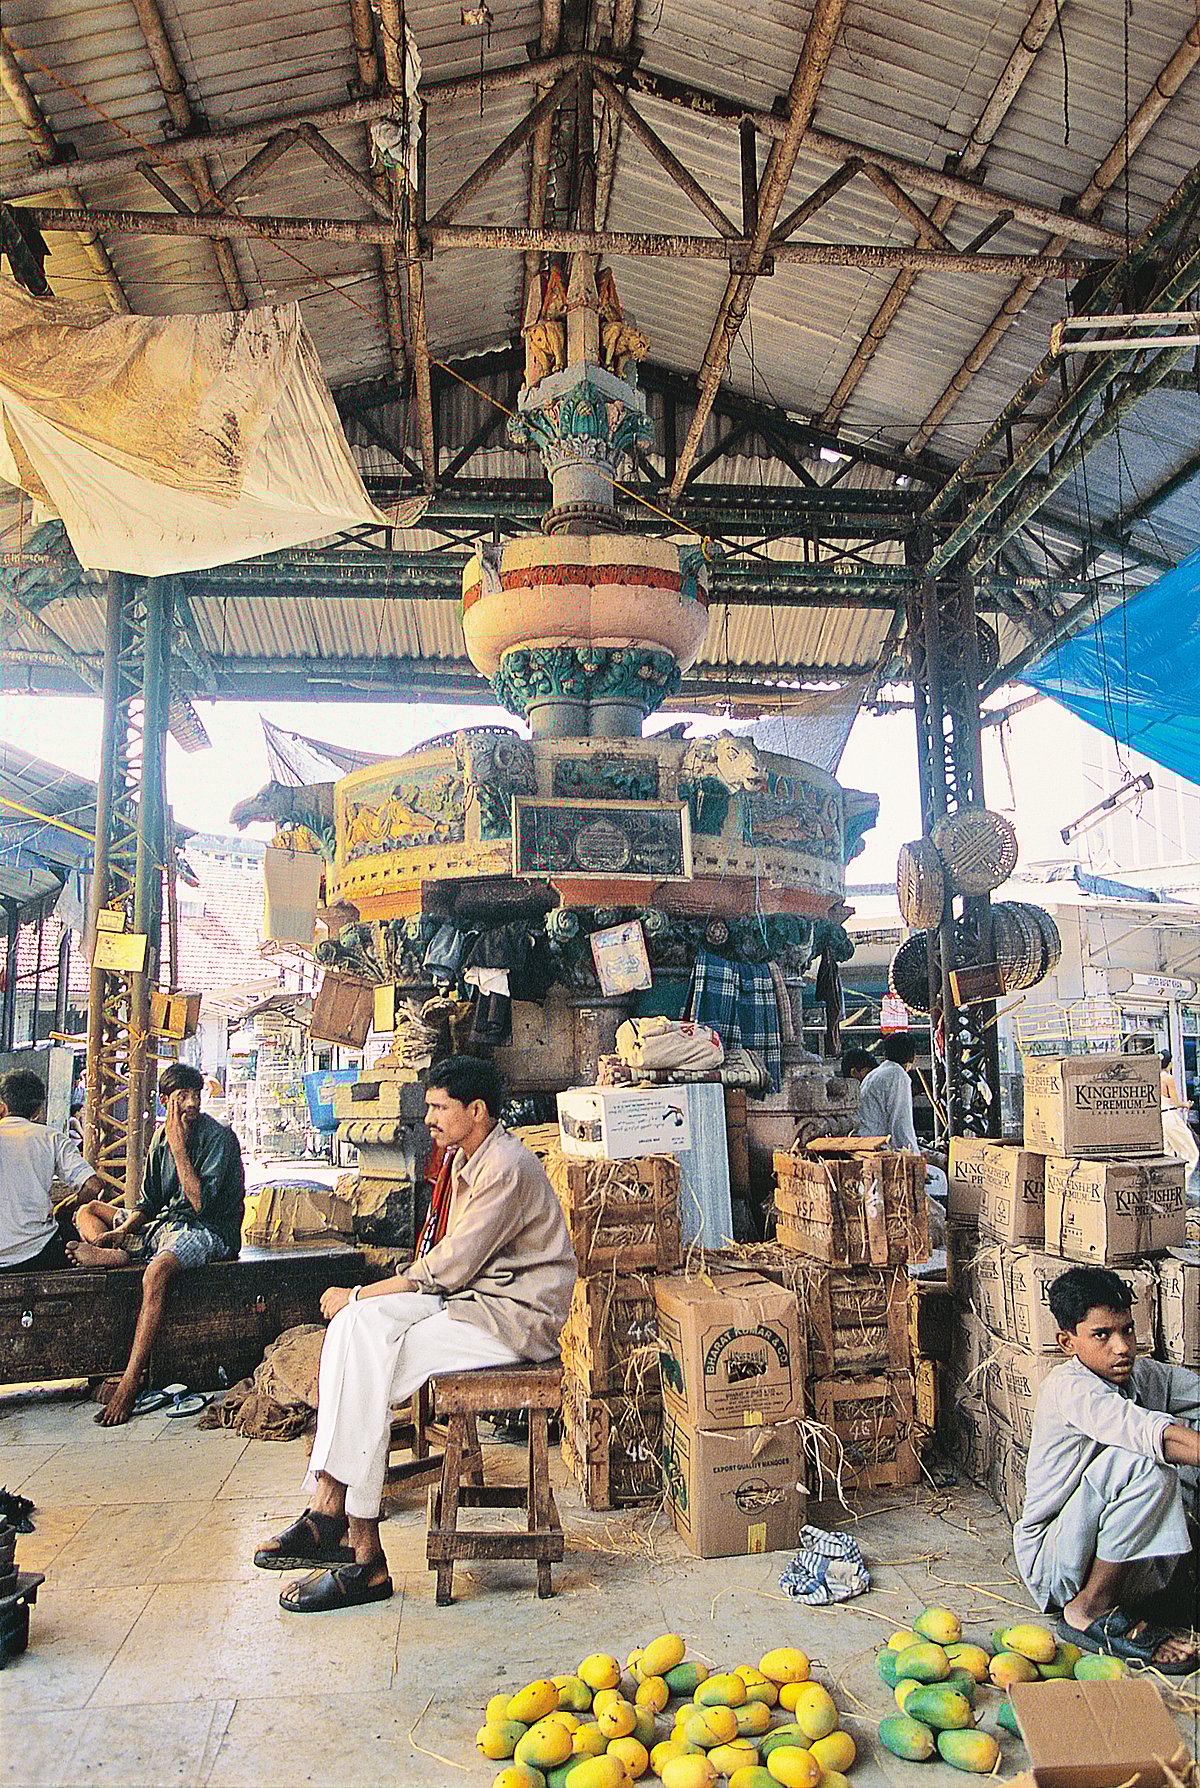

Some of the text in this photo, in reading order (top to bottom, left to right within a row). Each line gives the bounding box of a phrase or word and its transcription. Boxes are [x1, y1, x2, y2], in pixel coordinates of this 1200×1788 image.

[1074, 1084, 1158, 1105] KINGFISHER
[1095, 1100, 1143, 1110] PREMIUM
[706, 1330, 733, 1374] BHARAT
[735, 1326, 773, 1341] KUMAR
[771, 1336, 780, 1346] &
[712, 1464, 737, 1474] EXPORT
[737, 1460, 762, 1471] QUALITY
